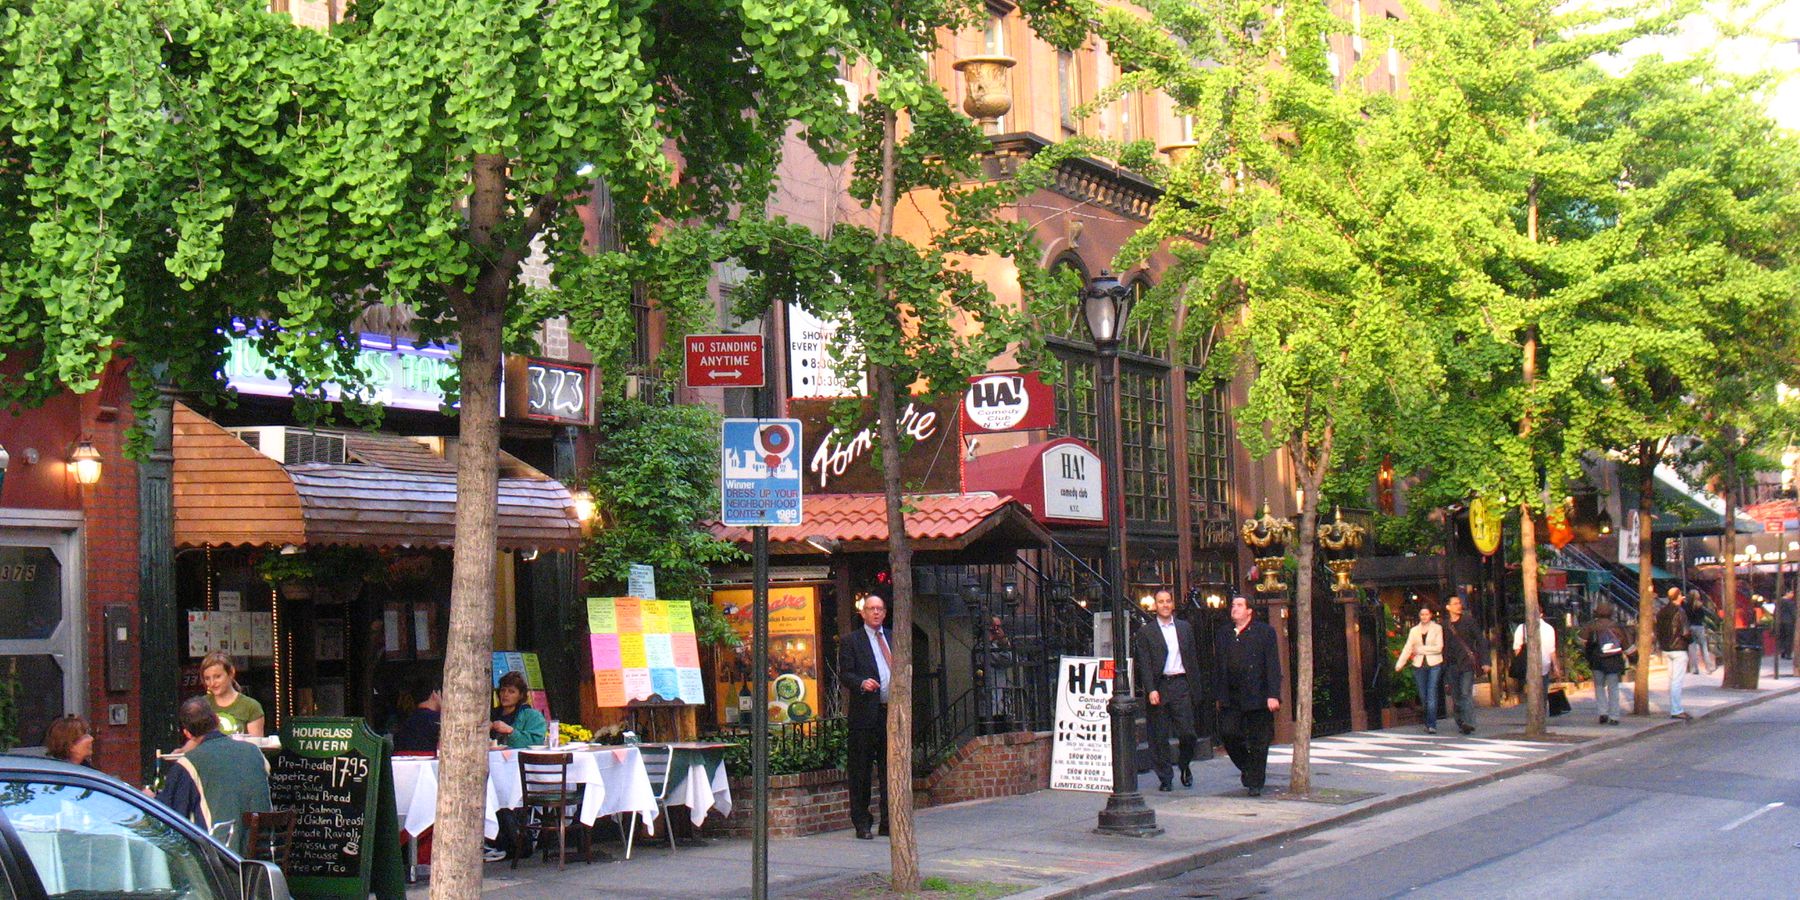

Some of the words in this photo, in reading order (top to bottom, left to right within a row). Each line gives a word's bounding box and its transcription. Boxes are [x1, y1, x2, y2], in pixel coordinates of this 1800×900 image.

[691, 341, 705, 353] NO
[710, 341, 757, 352] STANDING
[792, 341, 818, 352] EVERY
[700, 355, 750, 366] ANYTIME
[528, 366, 584, 414] 323
[972, 377, 1022, 409] HA!
[1061, 452, 1086, 481] HA!
[725, 479, 755, 489] Winner
[726, 488, 756, 498] DRESS
[760, 488, 771, 498] UP
[775, 488, 799, 498] YOUR
[1060, 487, 1078, 500] comedy
[1079, 487, 1088, 499] club
[726, 498, 797, 509] NEIGHBORHOOD
[776, 508, 797, 519] 1989
[1085, 703, 1102, 711] Club
[292, 727, 353, 739] HOURGLASS
[298, 740, 348, 751] TAVERN
[1068, 752, 1085, 760] SHOW
[1086, 753, 1103, 761] ROOM
[1084, 768, 1101, 776] ROOM
[322, 790, 351, 804] Bread
[309, 803, 342, 814] Salmon
[335, 812, 364, 828] Breast
[324, 826, 359, 839] Ravioli
